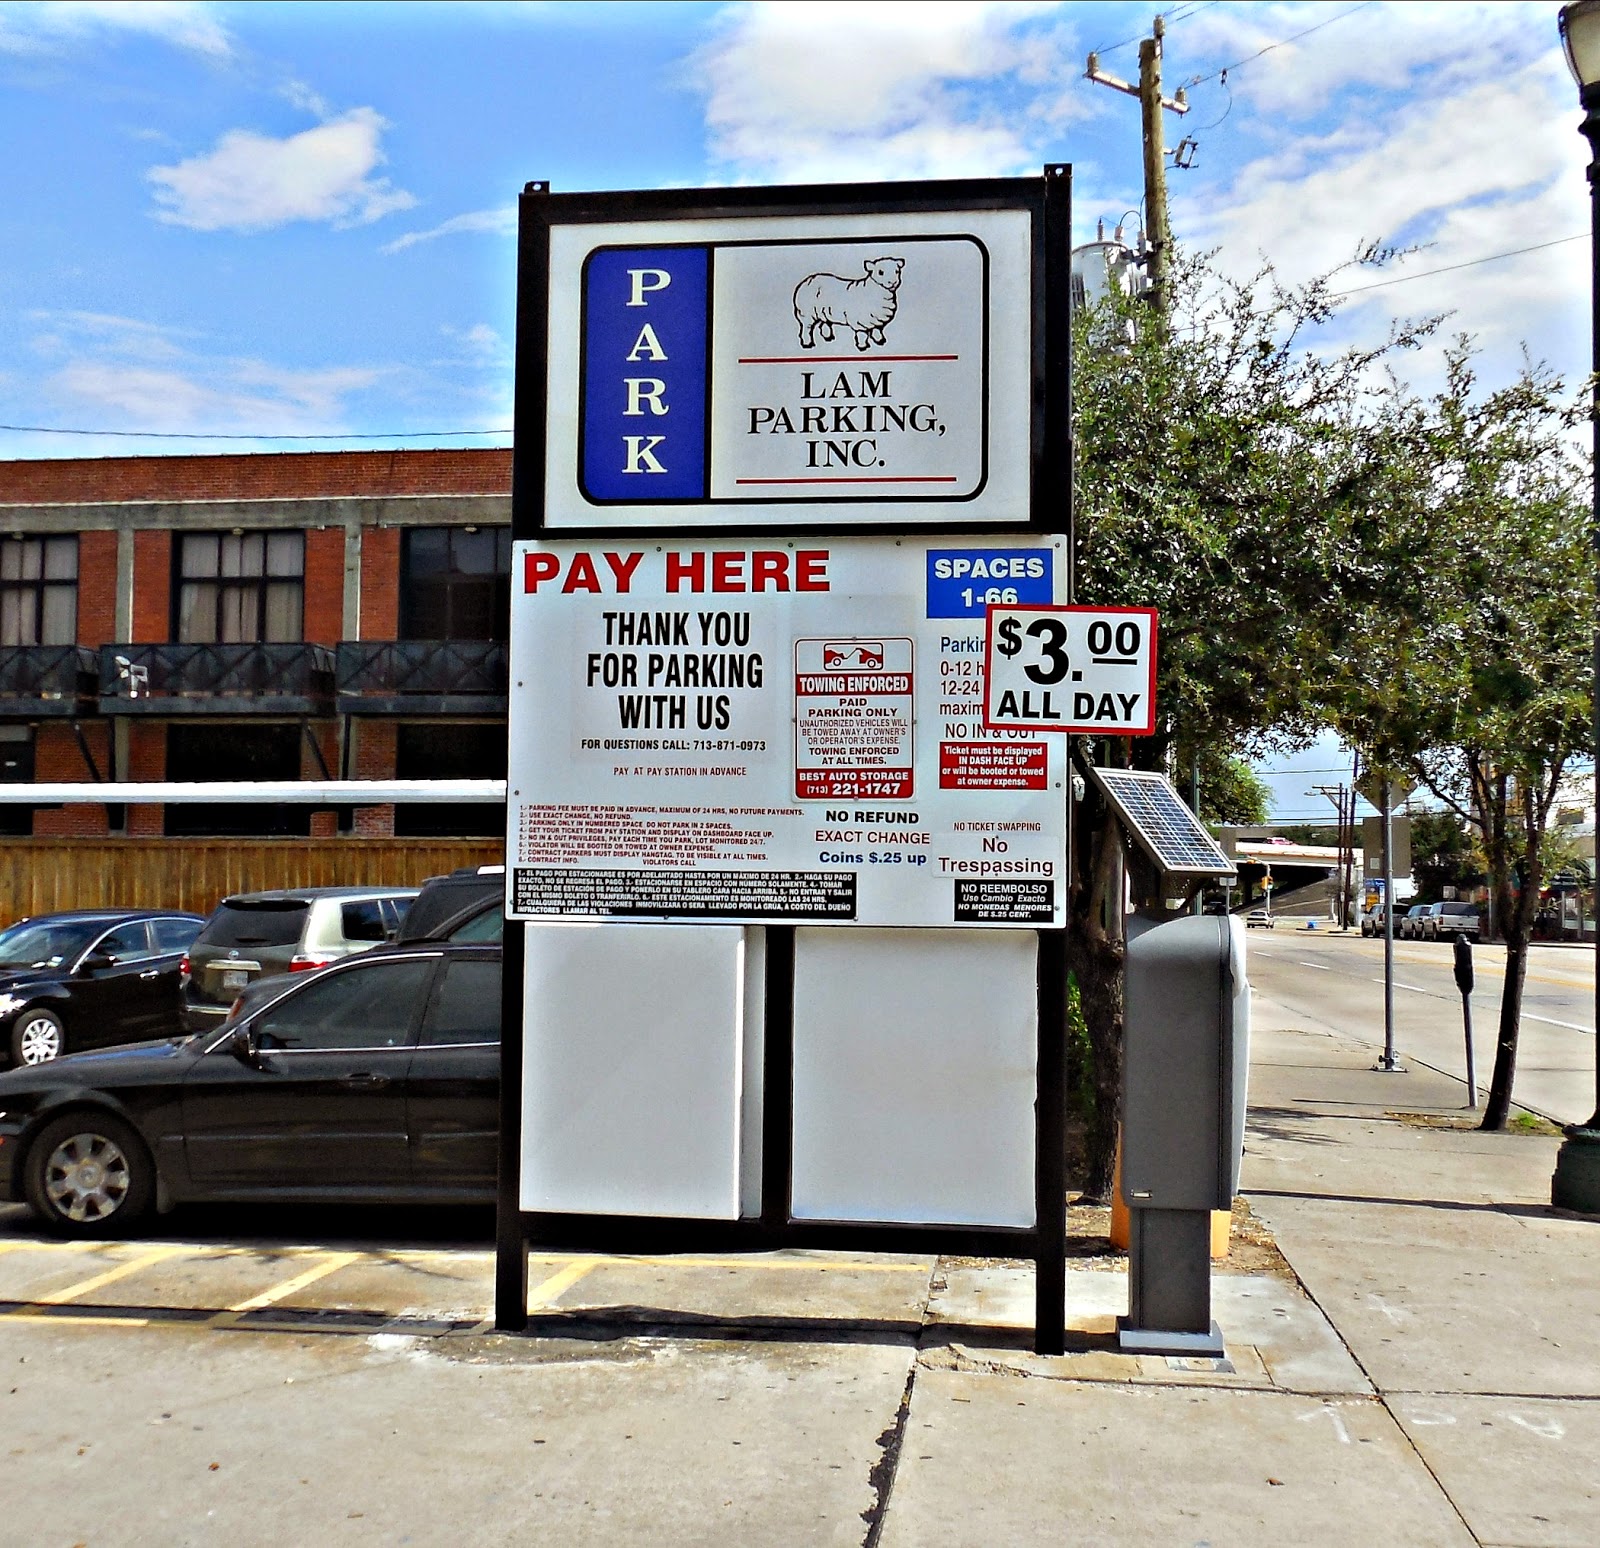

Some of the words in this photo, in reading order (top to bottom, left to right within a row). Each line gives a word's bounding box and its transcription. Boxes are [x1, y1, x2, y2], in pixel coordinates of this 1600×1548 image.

[621, 269, 671, 474] PARK
[800, 371, 892, 399] LAM
[747, 404, 947, 435] PARKING,
[805, 439, 886, 468] INC.
[524, 552, 644, 594] PAY
[666, 550, 829, 593] HERE
[935, 558, 1044, 578] SPACES
[961, 588, 1017, 607] 1-66
[602, 612, 689, 646] THANK
[699, 612, 750, 646] YOU
[587, 654, 637, 687] FOR
[650, 654, 763, 688] PARKING
[940, 661, 971, 676] 0-12
[800, 677, 845, 692] TOWING
[848, 676, 908, 692] ENFORCED
[941, 681, 980, 695] 12-24
[618, 695, 685, 729] WITH
[697, 695, 730, 730] US
[809, 709, 861, 717] PARKING
[866, 708, 897, 716] ONLY
[940, 701, 984, 715] maxim
[996, 690, 1061, 719] ALL
[1074, 692, 1141, 721] DAY
[856, 719, 890, 727] VEHICLES
[945, 723, 967, 738] NO
[973, 723, 987, 738] IN
[581, 739, 600, 749] FOR
[604, 739, 659, 750] QUESTIONS
[662, 740, 689, 750] CALL:
[693, 741, 766, 751] 713-871-0973
[850, 747, 899, 755] ENFORCED
[944, 746, 969, 754] Ticket
[971, 747, 991, 755] must
[993, 747, 1002, 755] be
[1005, 747, 1042, 757] displayed
[970, 757, 991, 765] DASH
[994, 757, 1013, 765] FACE
[1016, 757, 1027, 765] UP
[614, 767, 629, 775] PAY
[634, 767, 643, 775] AT
[647, 767, 661, 775] PAY
[665, 768, 697, 776] STATION
[710, 767, 746, 775] ADVANCE
[800, 772, 825, 780] BEST
[860, 772, 908, 780] STORAGE
[980, 767, 1007, 775] booted
[1019, 767, 1043, 775] towed
[807, 785, 828, 794] (713)
[832, 783, 900, 795] 221-1747
[994, 778, 1028, 787] expense.
[826, 811, 848, 821] NO
[855, 811, 919, 823] REFUND
[954, 823, 965, 831] NO
[968, 823, 995, 831] TICKET
[997, 823, 1040, 831] SWAPPING
[816, 831, 863, 842] EXACT
[867, 832, 930, 844] CHANGE
[983, 838, 1008, 852] No
[820, 851, 863, 863] Coins
[869, 851, 901, 863] $.25
[908, 855, 927, 865] up
[939, 857, 1054, 876] Trespassing
[961, 884, 977, 893] NO
[980, 884, 1047, 893] REEMBOLSO
